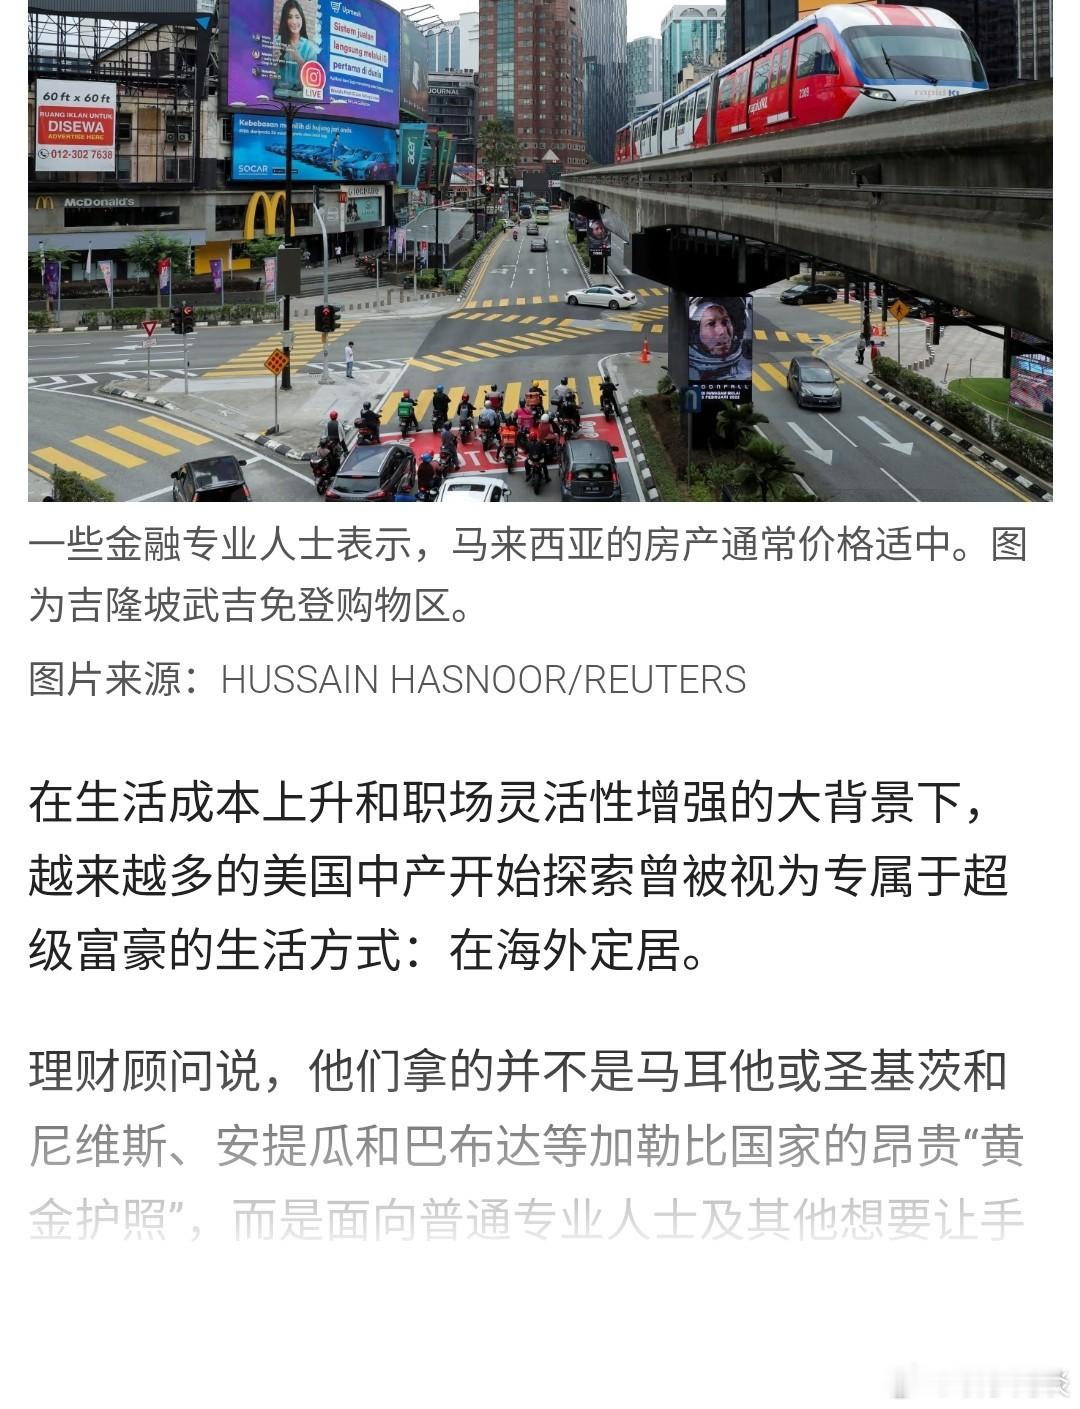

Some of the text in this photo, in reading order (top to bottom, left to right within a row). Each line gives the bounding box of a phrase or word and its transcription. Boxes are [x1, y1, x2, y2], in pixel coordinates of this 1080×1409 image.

[333, 40, 363, 58] langsung
[333, 61, 360, 73] pertama
[43, 92, 58, 101] 60
[60, 92, 70, 102] ft
[84, 94, 99, 103] 60
[101, 94, 111, 103] ft
[305, 89, 321, 98] LIVE
[48, 121, 104, 133] DISEWA
[239, 119, 279, 129] Kebebasan
[51, 149, 113, 159] 012-302 7638
[406, 137, 416, 165] acer
[64, 197, 136, 207] McDonald's
[30, 586, 465, 622] 为吉隆坡武吉免登购物区。
[223, 665, 376, 693] HUSSAIN
[393, 665, 745, 695] HASNOOR/REUTERS
[29, 779, 978, 824] 在生活成本上升和职场灵活性增强的大背景下，
[29, 853, 1008, 897] 越来越多的美国中产开始探索曾被视为专属于超
[29, 927, 698, 971] 级富豪的生活方式：在海外定居。
[29, 1048, 1005, 1093] 理财顾问说，他们拿的并不是马耳他或圣基茨和
